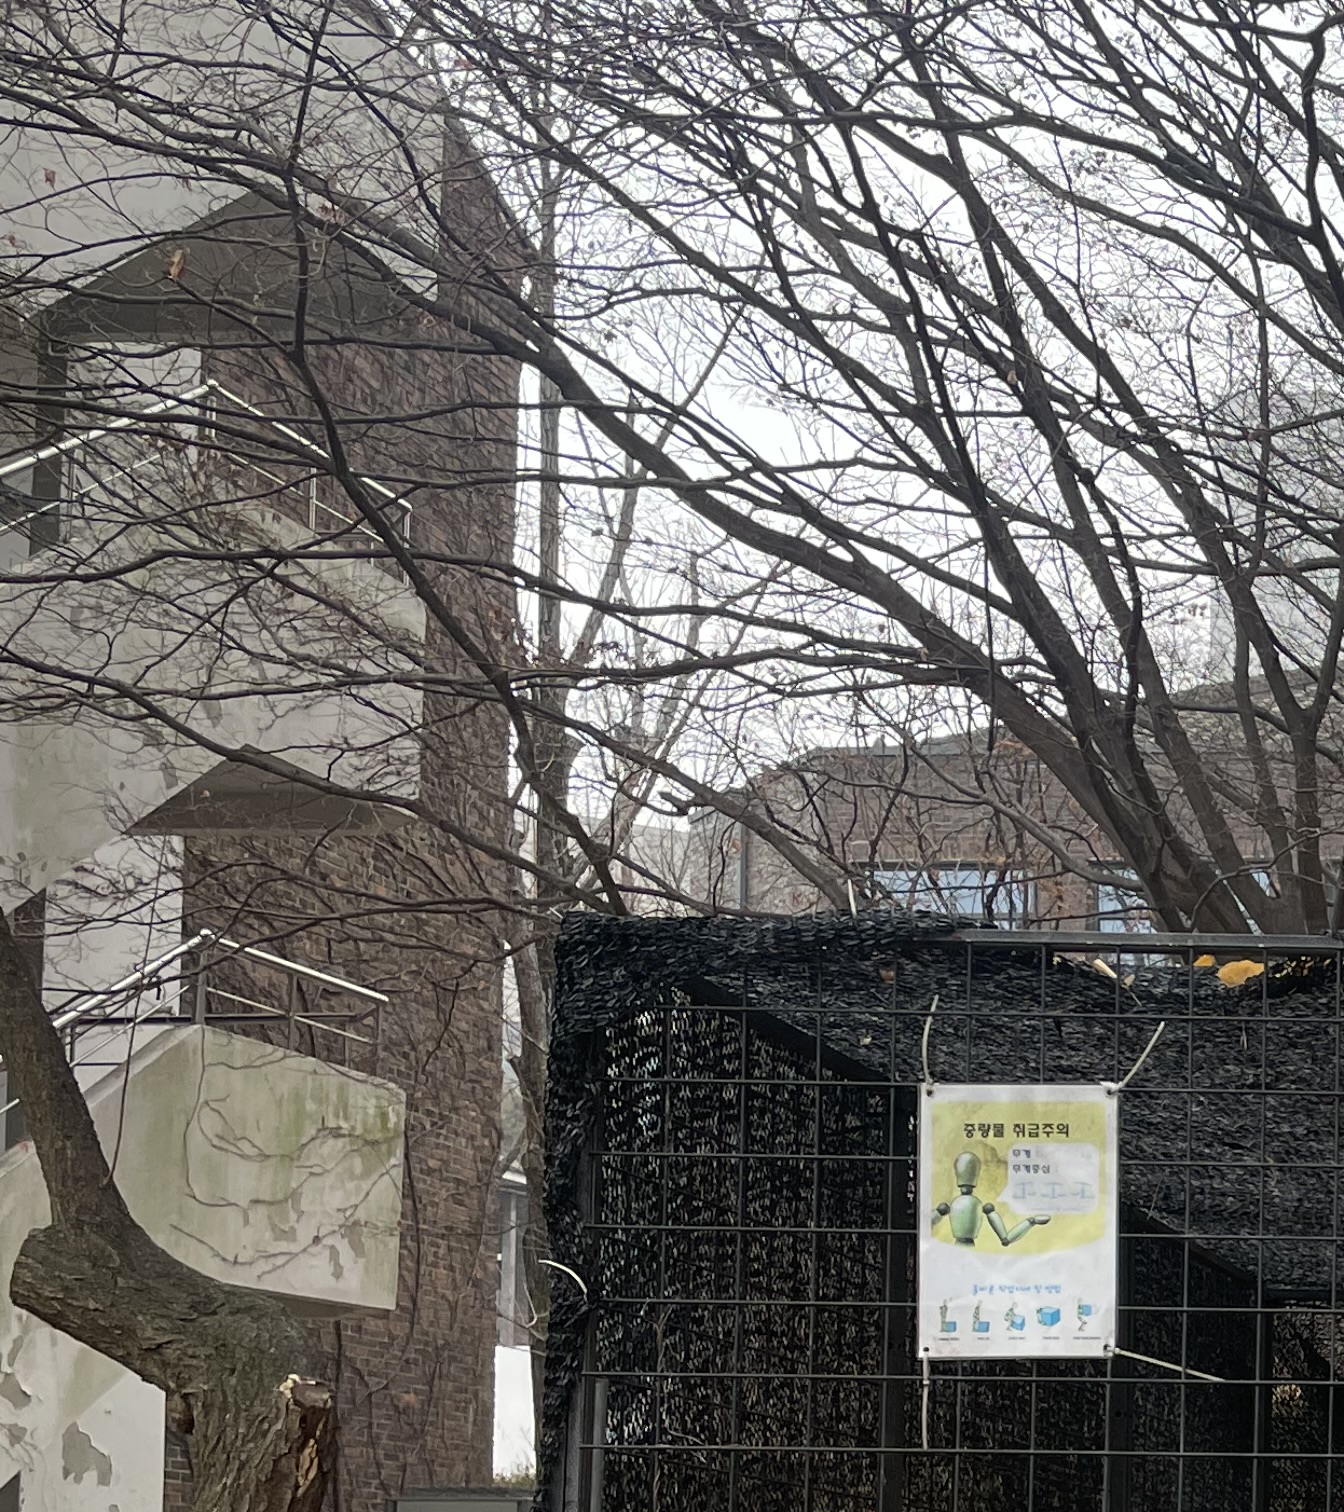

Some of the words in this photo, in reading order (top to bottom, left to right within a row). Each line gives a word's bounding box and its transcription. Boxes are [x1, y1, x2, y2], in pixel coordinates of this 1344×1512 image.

[964, 1123, 1005, 1138] 중량물
[1013, 1123, 1069, 1138] 취급주의
[1013, 1149, 1031, 1158] 무게
[1013, 1164, 1051, 1174] 무게중심
